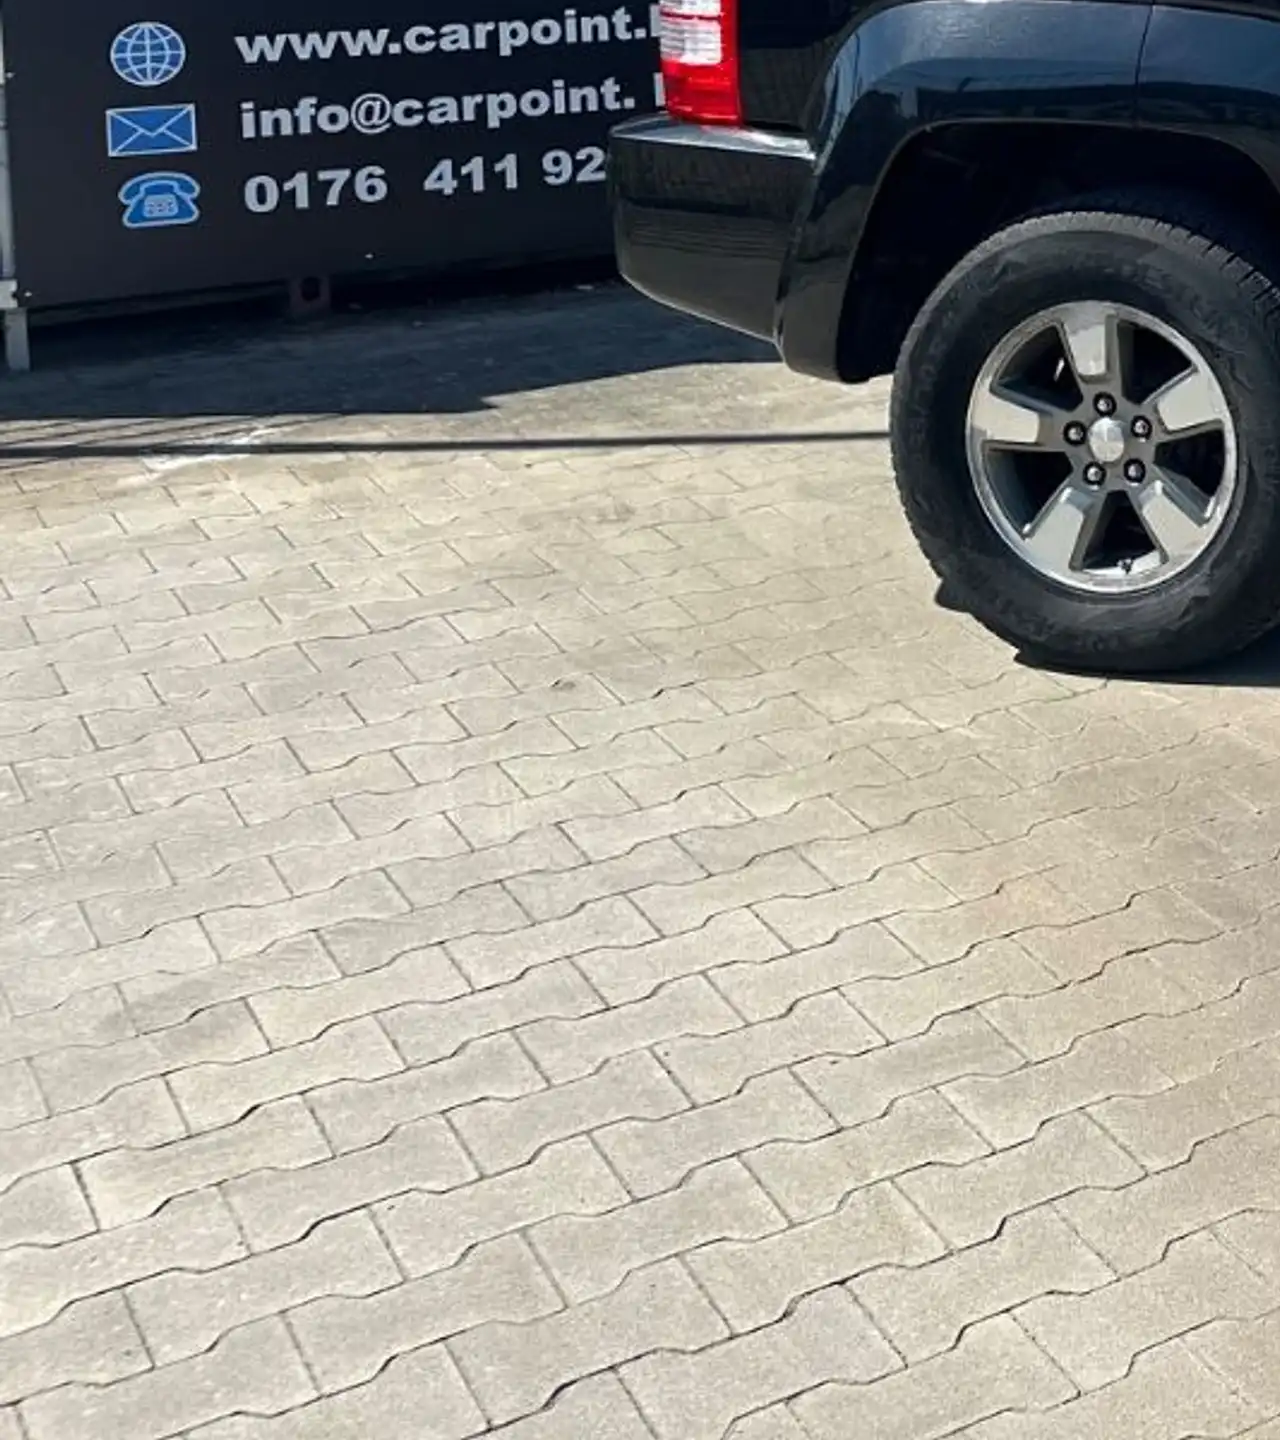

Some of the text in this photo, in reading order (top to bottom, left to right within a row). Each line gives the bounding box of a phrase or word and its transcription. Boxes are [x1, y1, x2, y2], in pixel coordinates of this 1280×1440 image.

[240, 77, 635, 139] info@carpoint.
[244, 146, 607, 213] 0176 411 92
